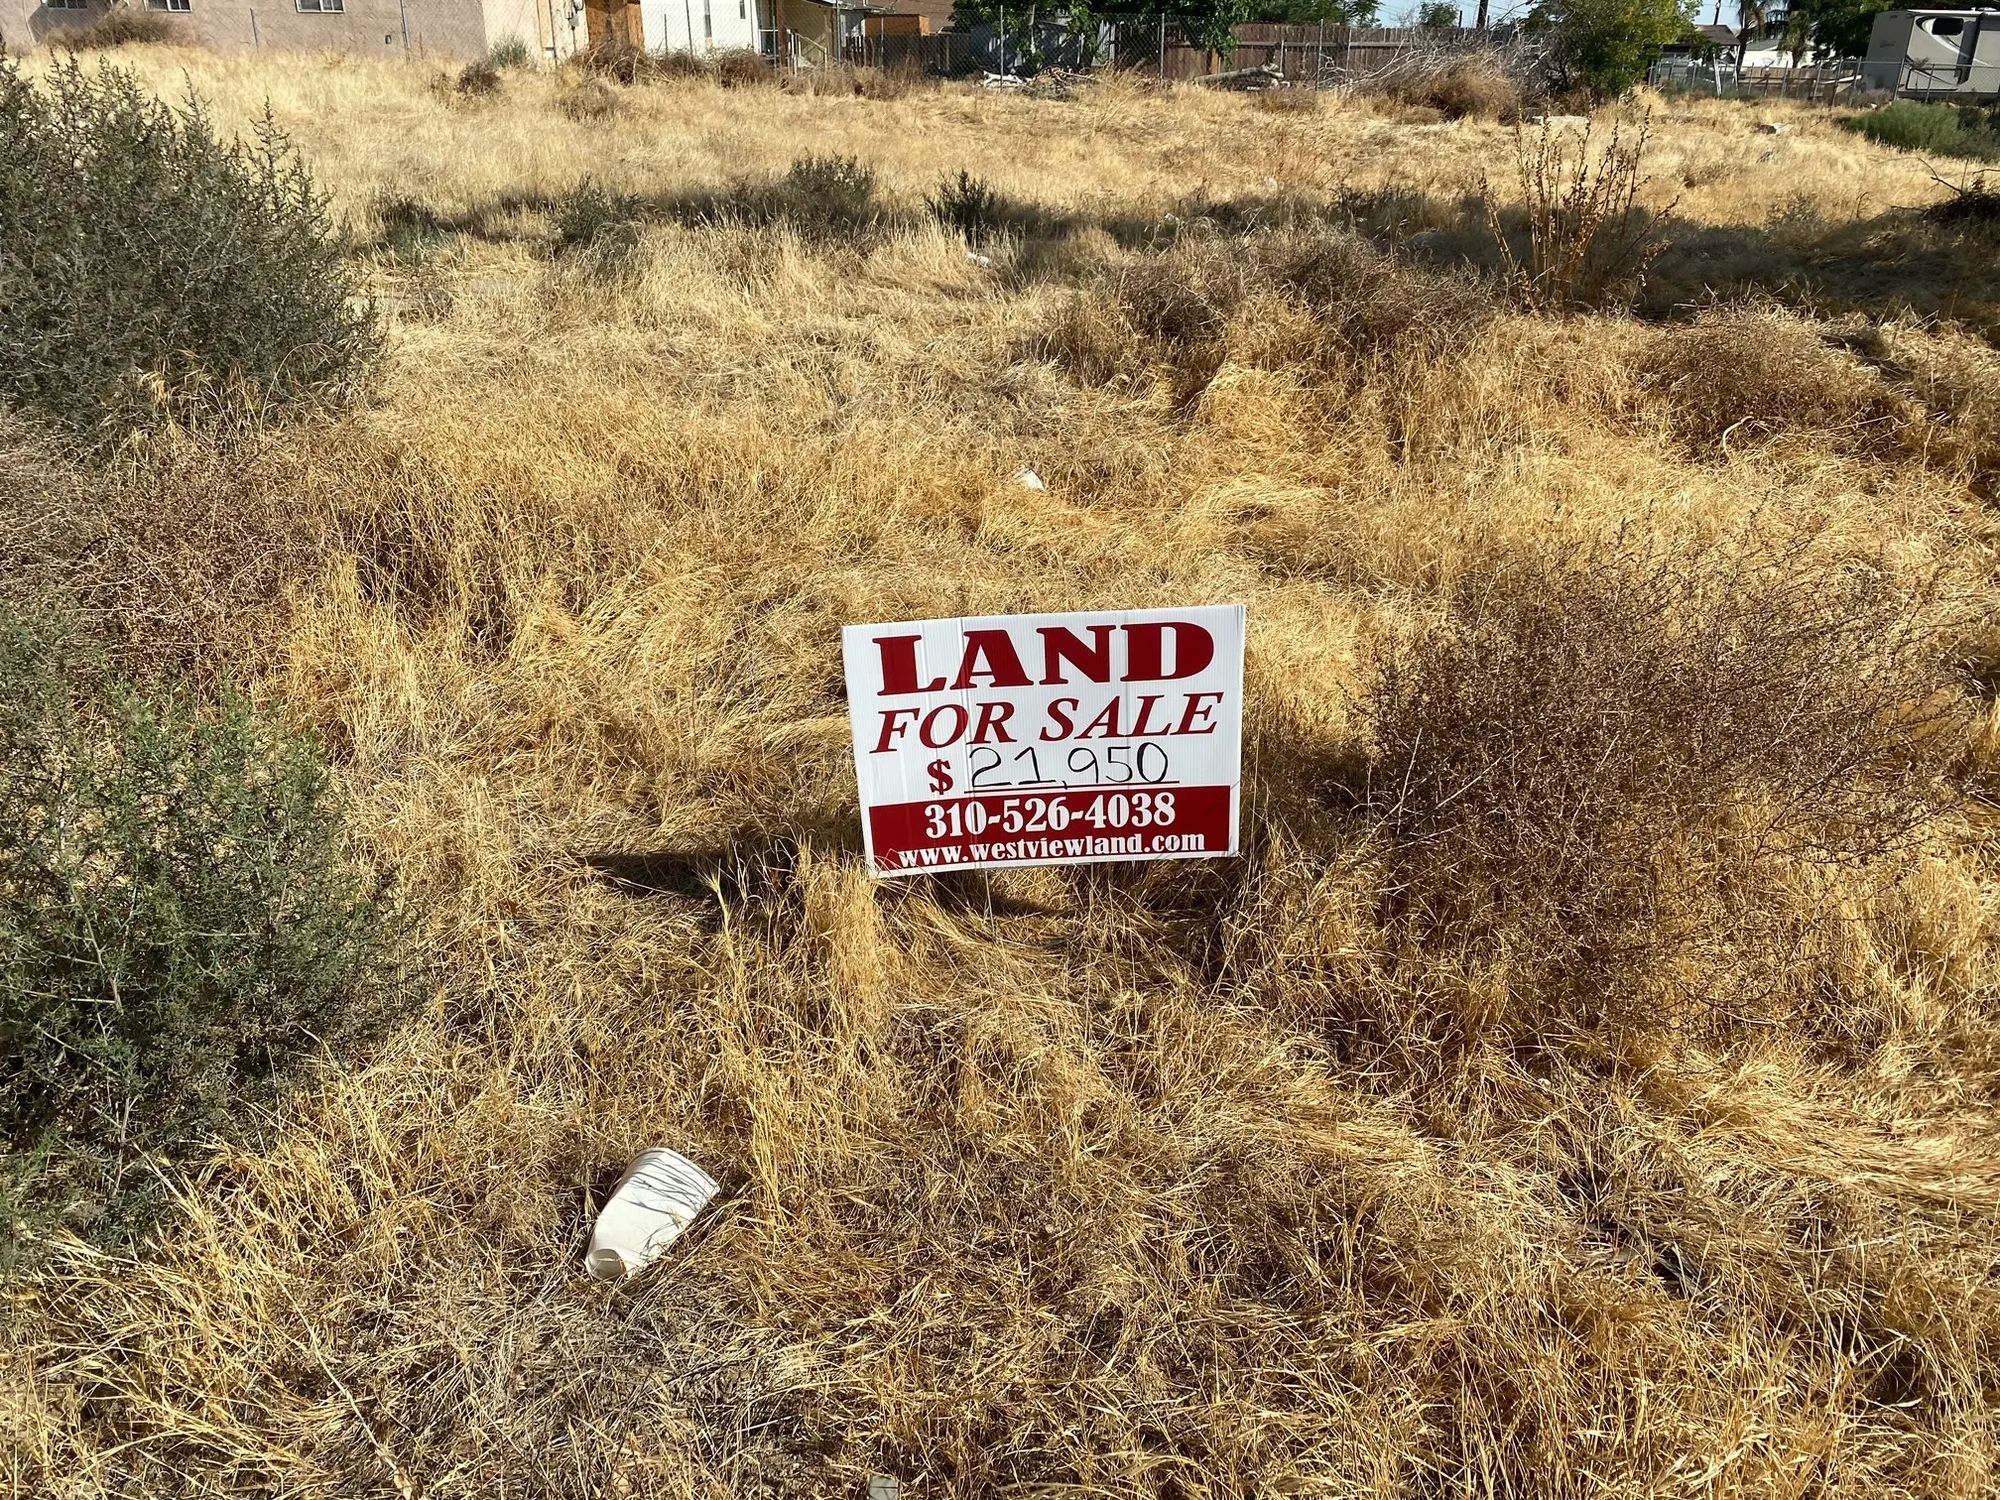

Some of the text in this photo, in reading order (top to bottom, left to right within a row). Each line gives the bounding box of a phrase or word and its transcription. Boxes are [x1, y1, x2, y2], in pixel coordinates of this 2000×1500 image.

[872, 622, 1214, 696] LAND
[869, 692, 1224, 754] FOR SALE
[926, 741, 1169, 795] $ 21,950
[924, 792, 1177, 839] 310-526-4038
[897, 832, 1206, 868] www.westviewland.com
